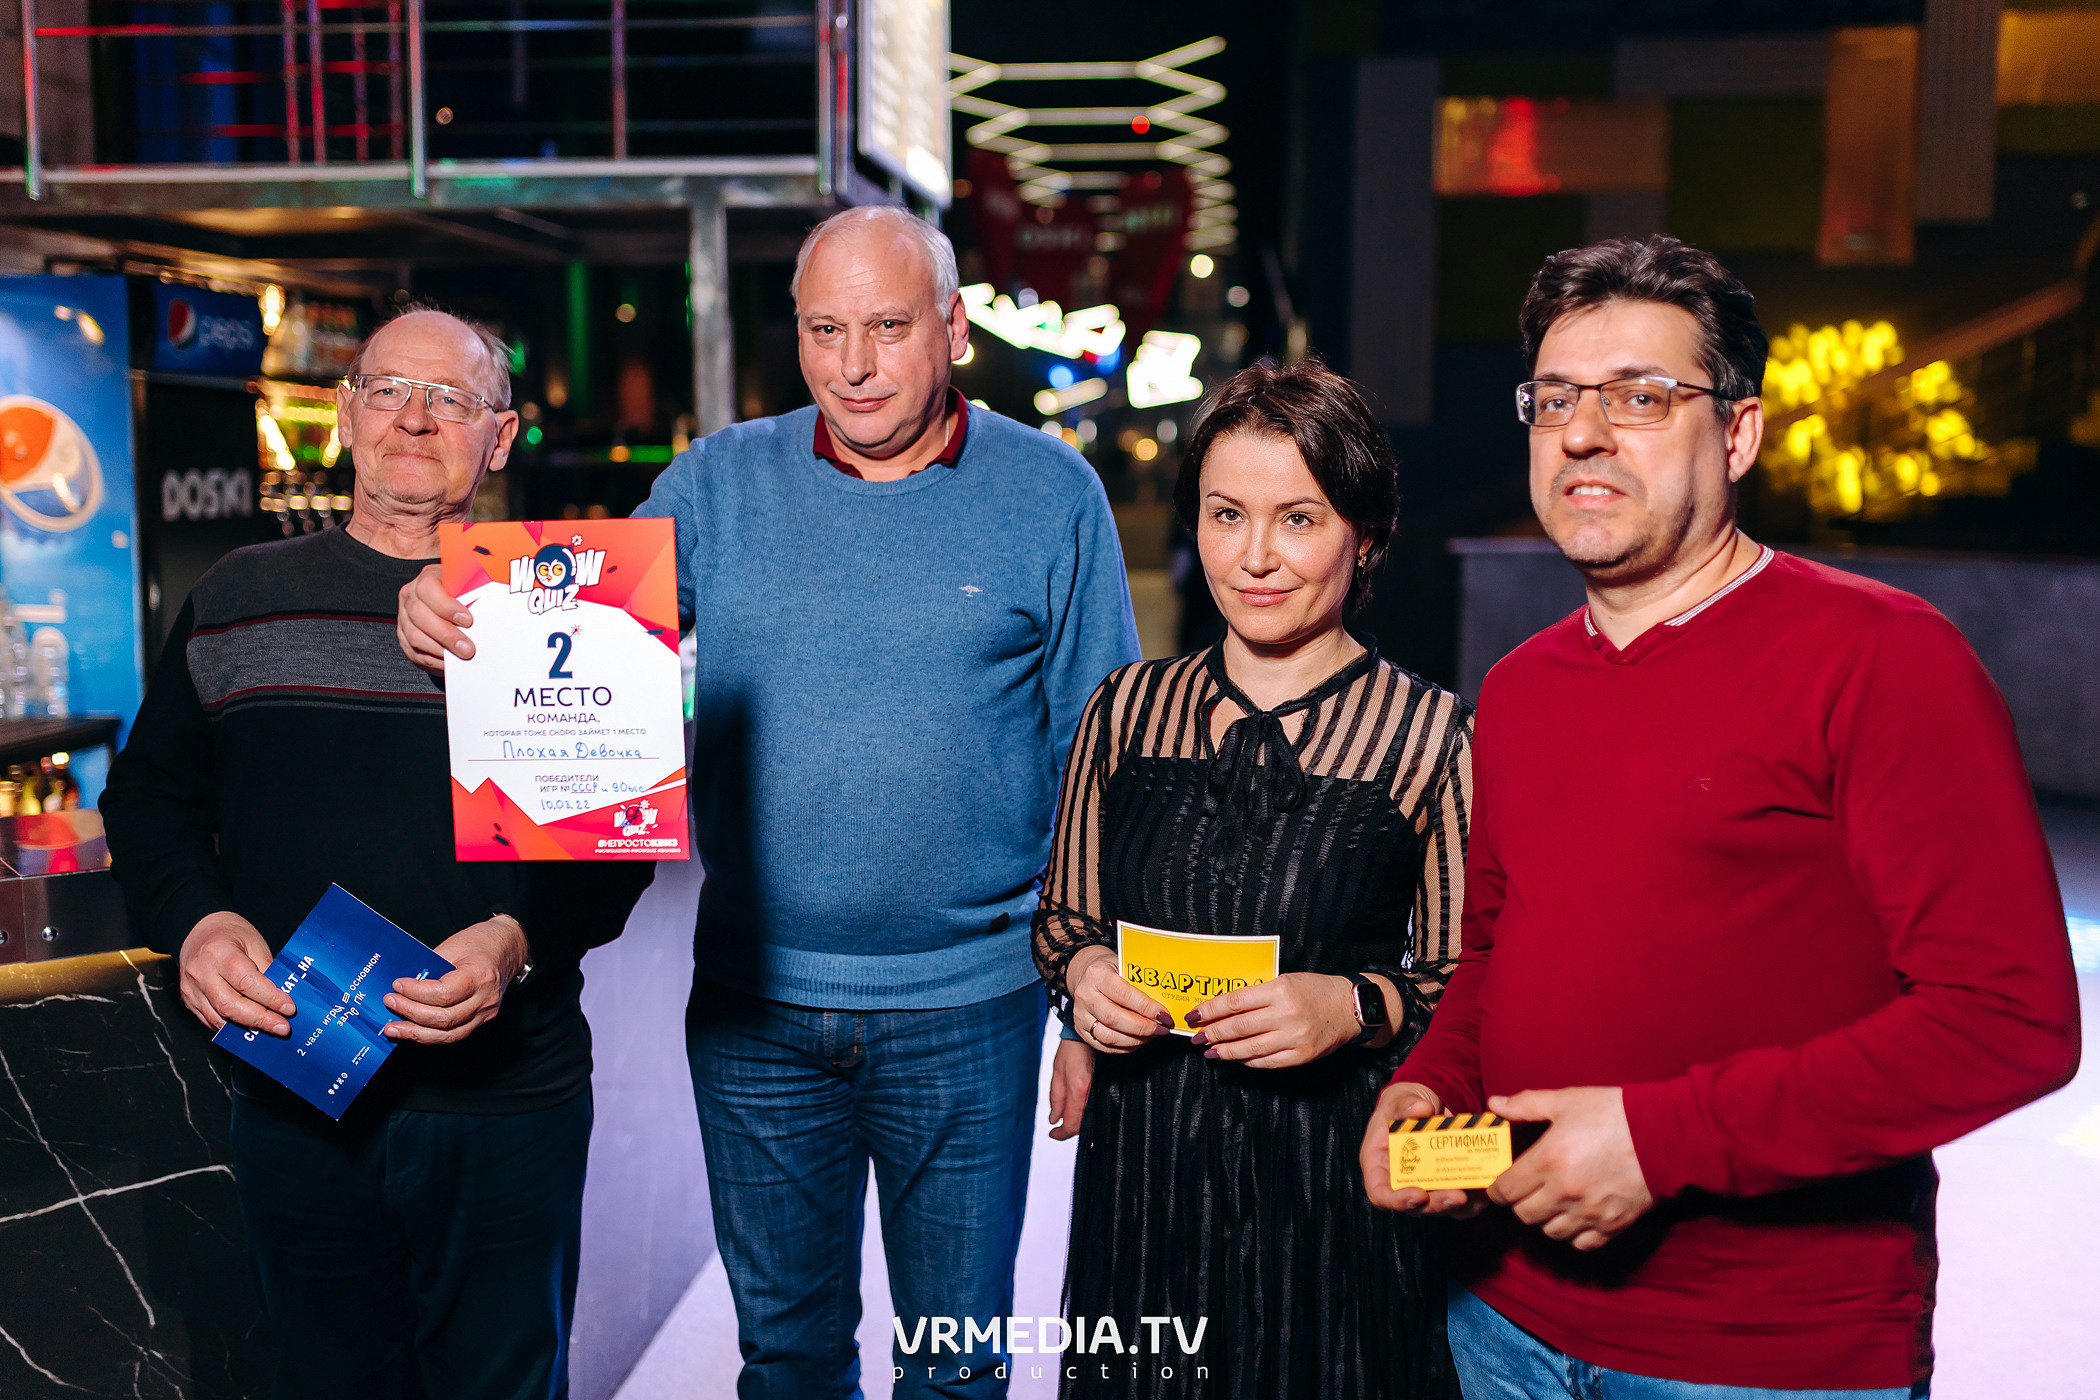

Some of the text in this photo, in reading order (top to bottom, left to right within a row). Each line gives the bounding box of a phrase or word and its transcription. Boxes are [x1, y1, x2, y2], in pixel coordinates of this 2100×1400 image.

[528, 583, 579, 615] QUIZ
[547, 632, 573, 679] 2
[514, 686, 612, 707] МЕСТО
[578, 727, 610, 736] ЗАЙМЕТ
[502, 740, 642, 759] Плохая Девочка
[535, 774, 599, 783] ПОБЕДИТЕЛИ
[540, 785, 558, 793] ИГР
[1161, 992, 1190, 1002] СТУДИЯ
[337, 991, 366, 1027] зале ПК
[297, 1048, 306, 1056] 2
[305, 1027, 324, 1047] часа
[322, 1005, 345, 1025] игры
[1430, 1133, 1499, 1150] СЕРТИФИКАТ
